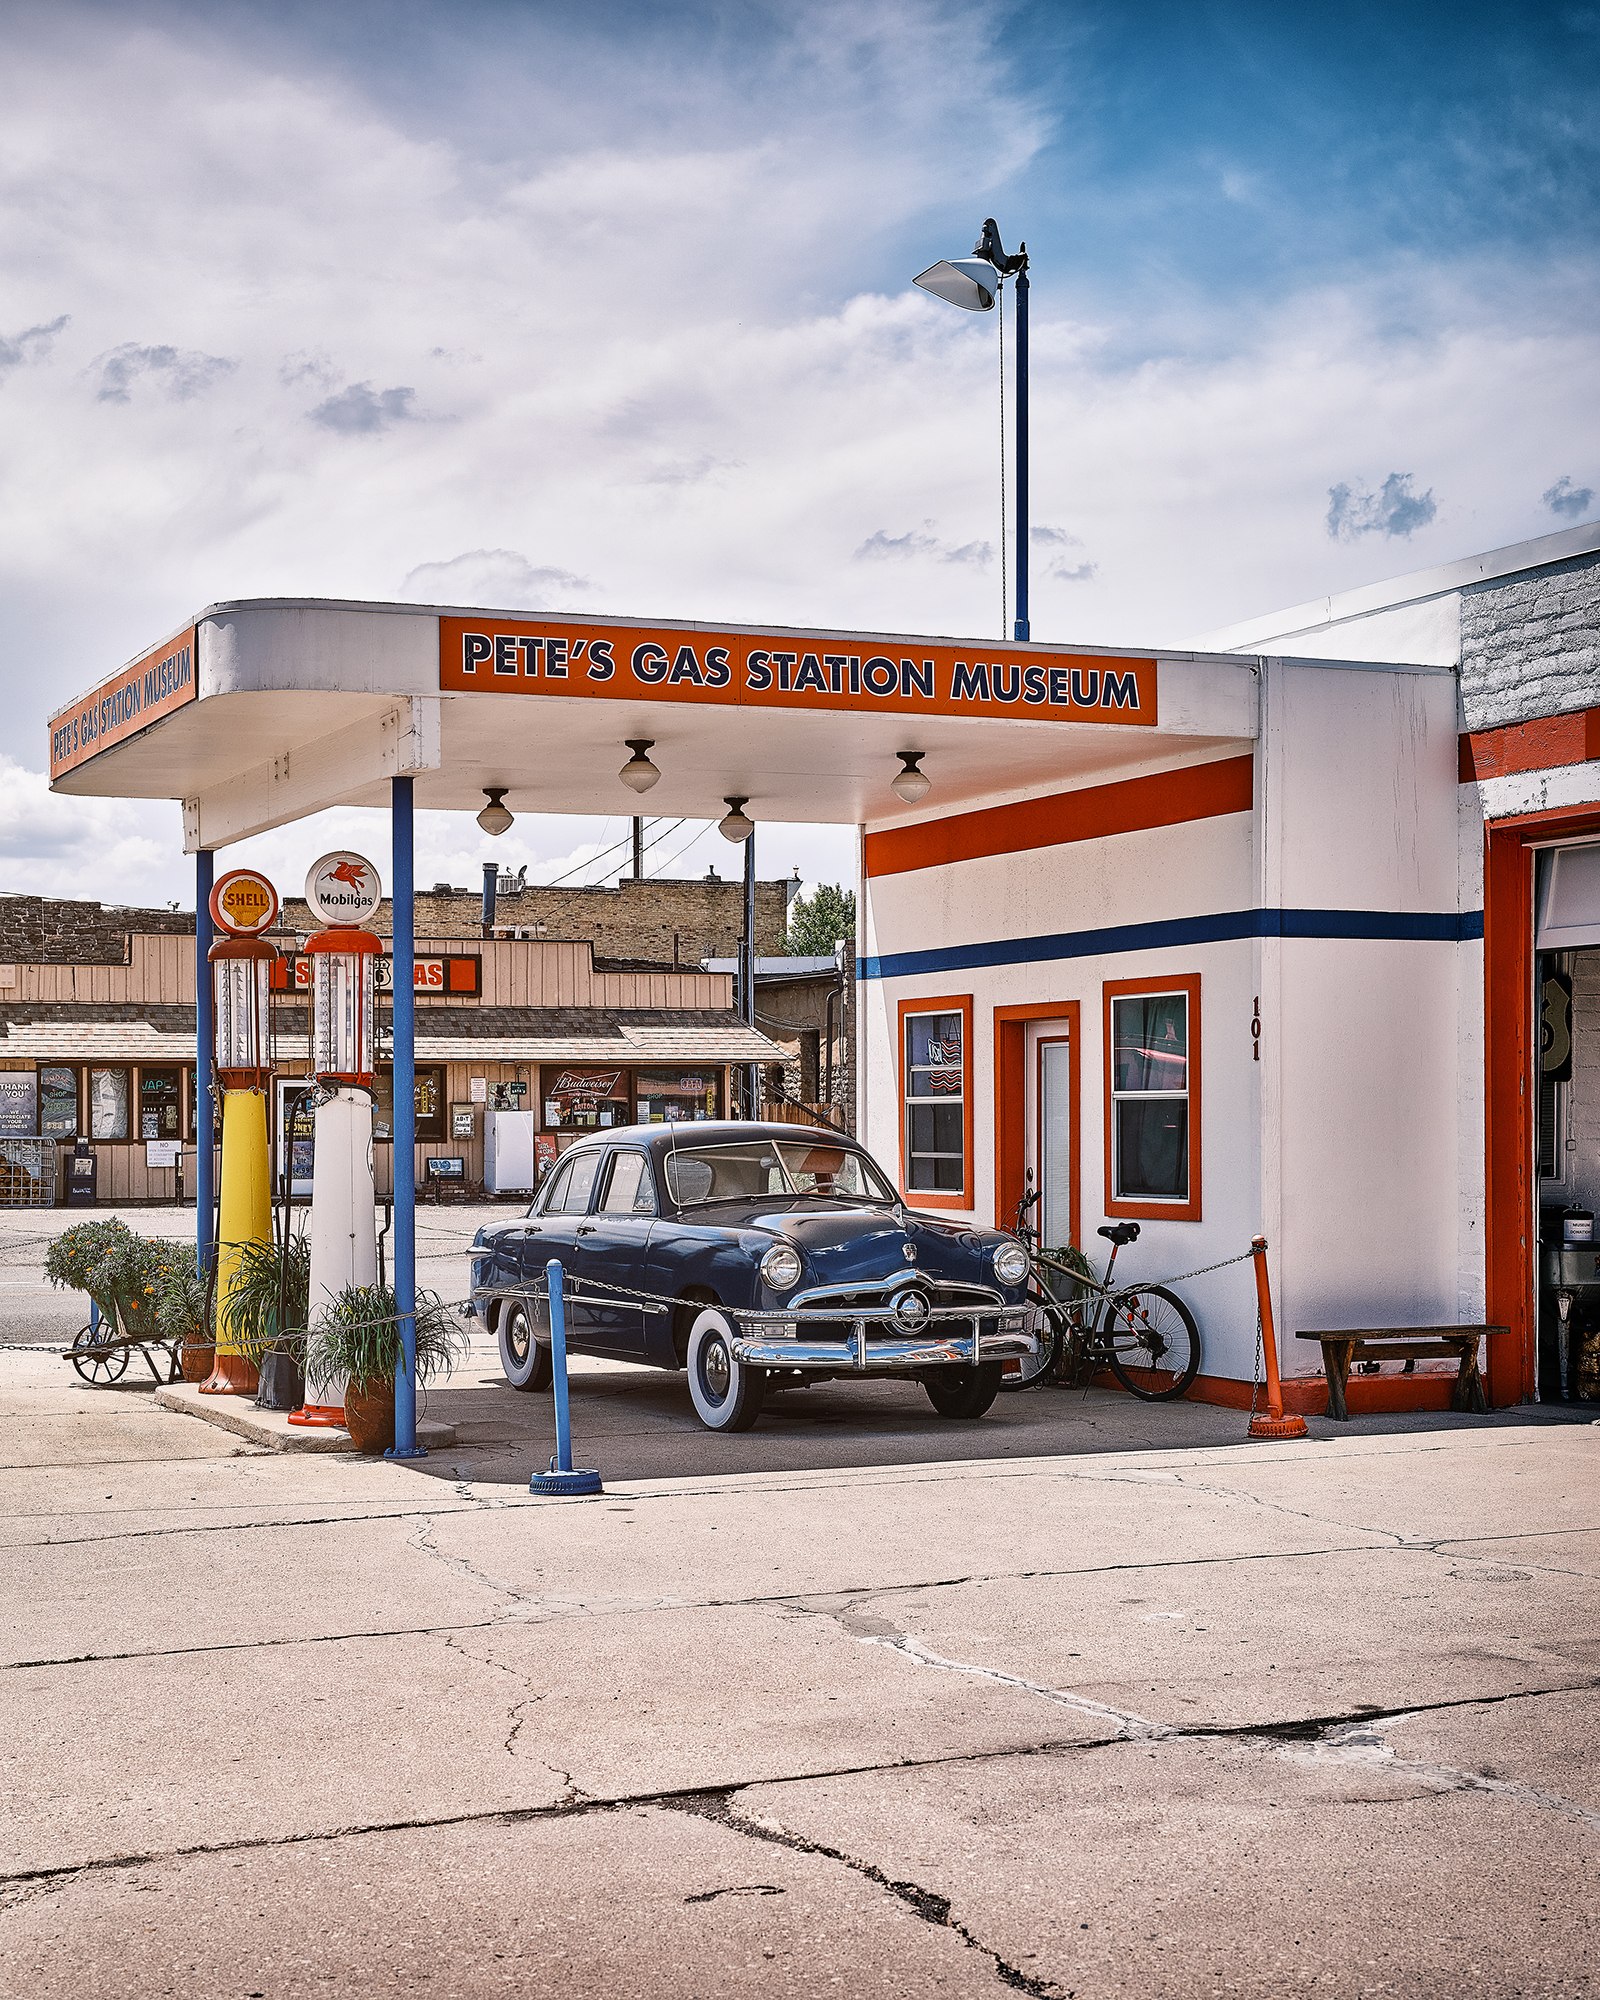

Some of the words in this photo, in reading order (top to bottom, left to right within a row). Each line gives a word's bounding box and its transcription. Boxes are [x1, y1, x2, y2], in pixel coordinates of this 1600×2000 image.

[461, 631, 615, 682] PETE'S
[630, 641, 731, 689] GAS
[745, 648, 936, 699] STATION
[950, 661, 1140, 710] MUSEUM
[53, 717, 78, 765] PETE'S
[80, 702, 99, 748] GAS
[100, 677, 141, 736] STATION
[143, 644, 192, 711] MUSEUM
[227, 893, 267, 907] SHELL
[320, 893, 373, 909] Mobilgas
[413, 963, 443, 985] AS
[1250, 995, 1262, 1061] 101
[557, 1077, 613, 1089] Budweiser
[285, 1122, 313, 1133] ONEY
